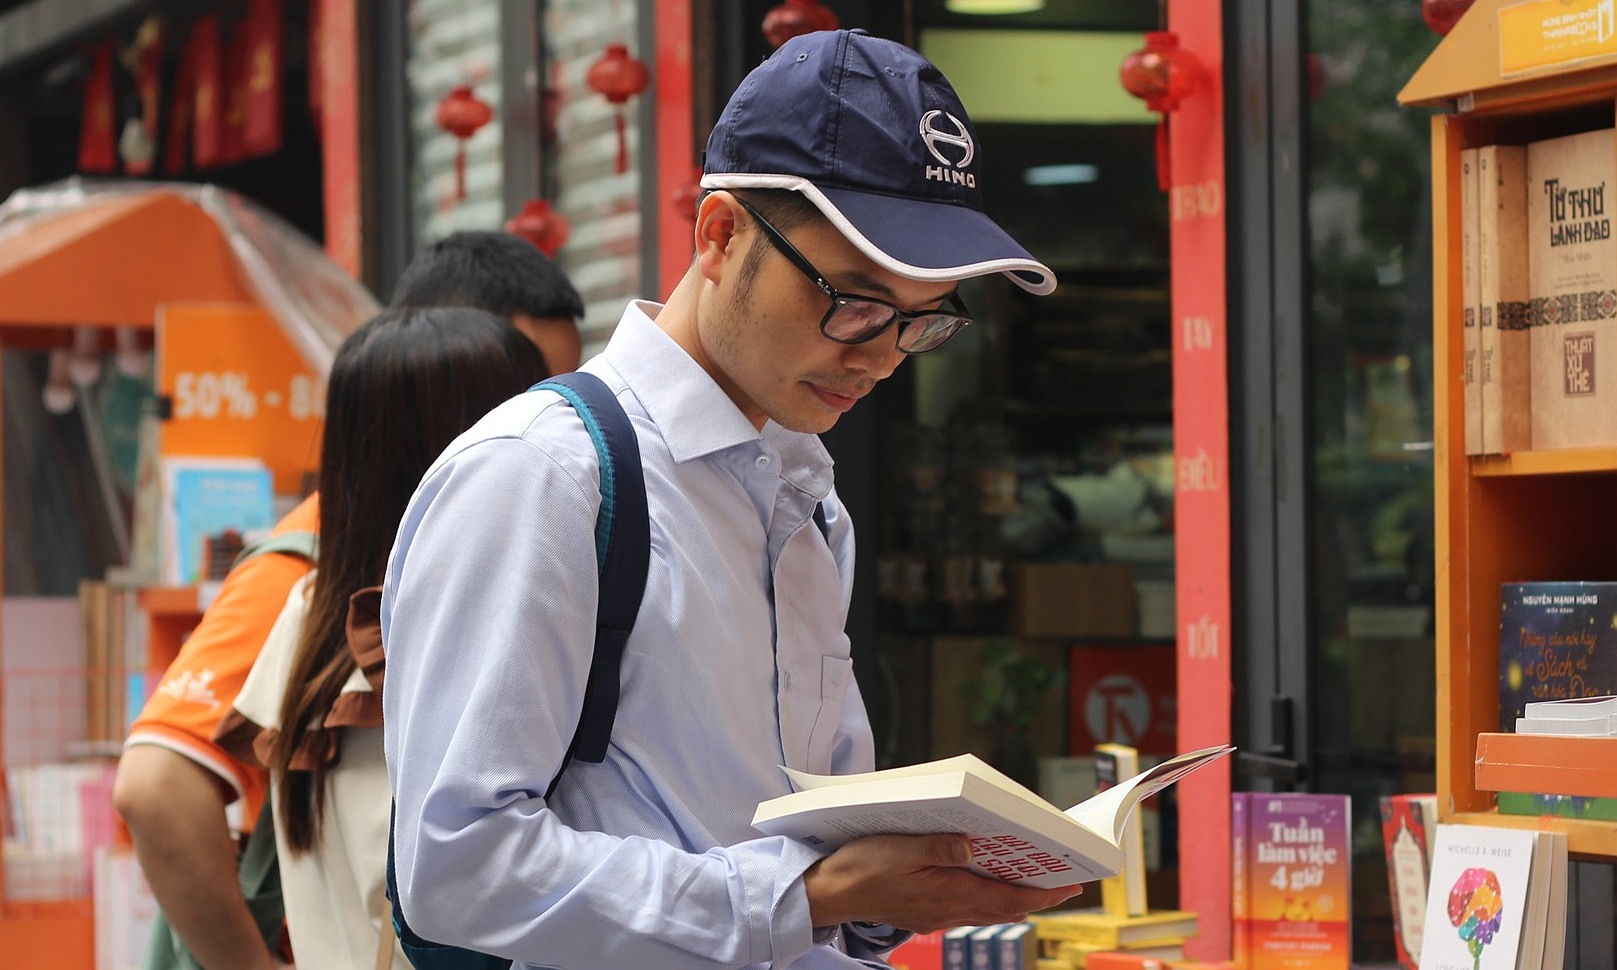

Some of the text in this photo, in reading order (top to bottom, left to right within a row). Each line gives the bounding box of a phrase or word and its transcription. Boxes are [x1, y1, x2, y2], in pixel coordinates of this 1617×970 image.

[926, 165, 976, 188] HINO
[174, 372, 258, 420] 50%
[1536, 648, 1574, 681] Sách
[1268, 816, 1325, 844] Tuần
[1257, 843, 1338, 867] làm việc
[1448, 844, 1480, 856] MICHELLE
[1491, 848, 1512, 858] WEISE
[1269, 865, 1325, 892] 4 giờ
